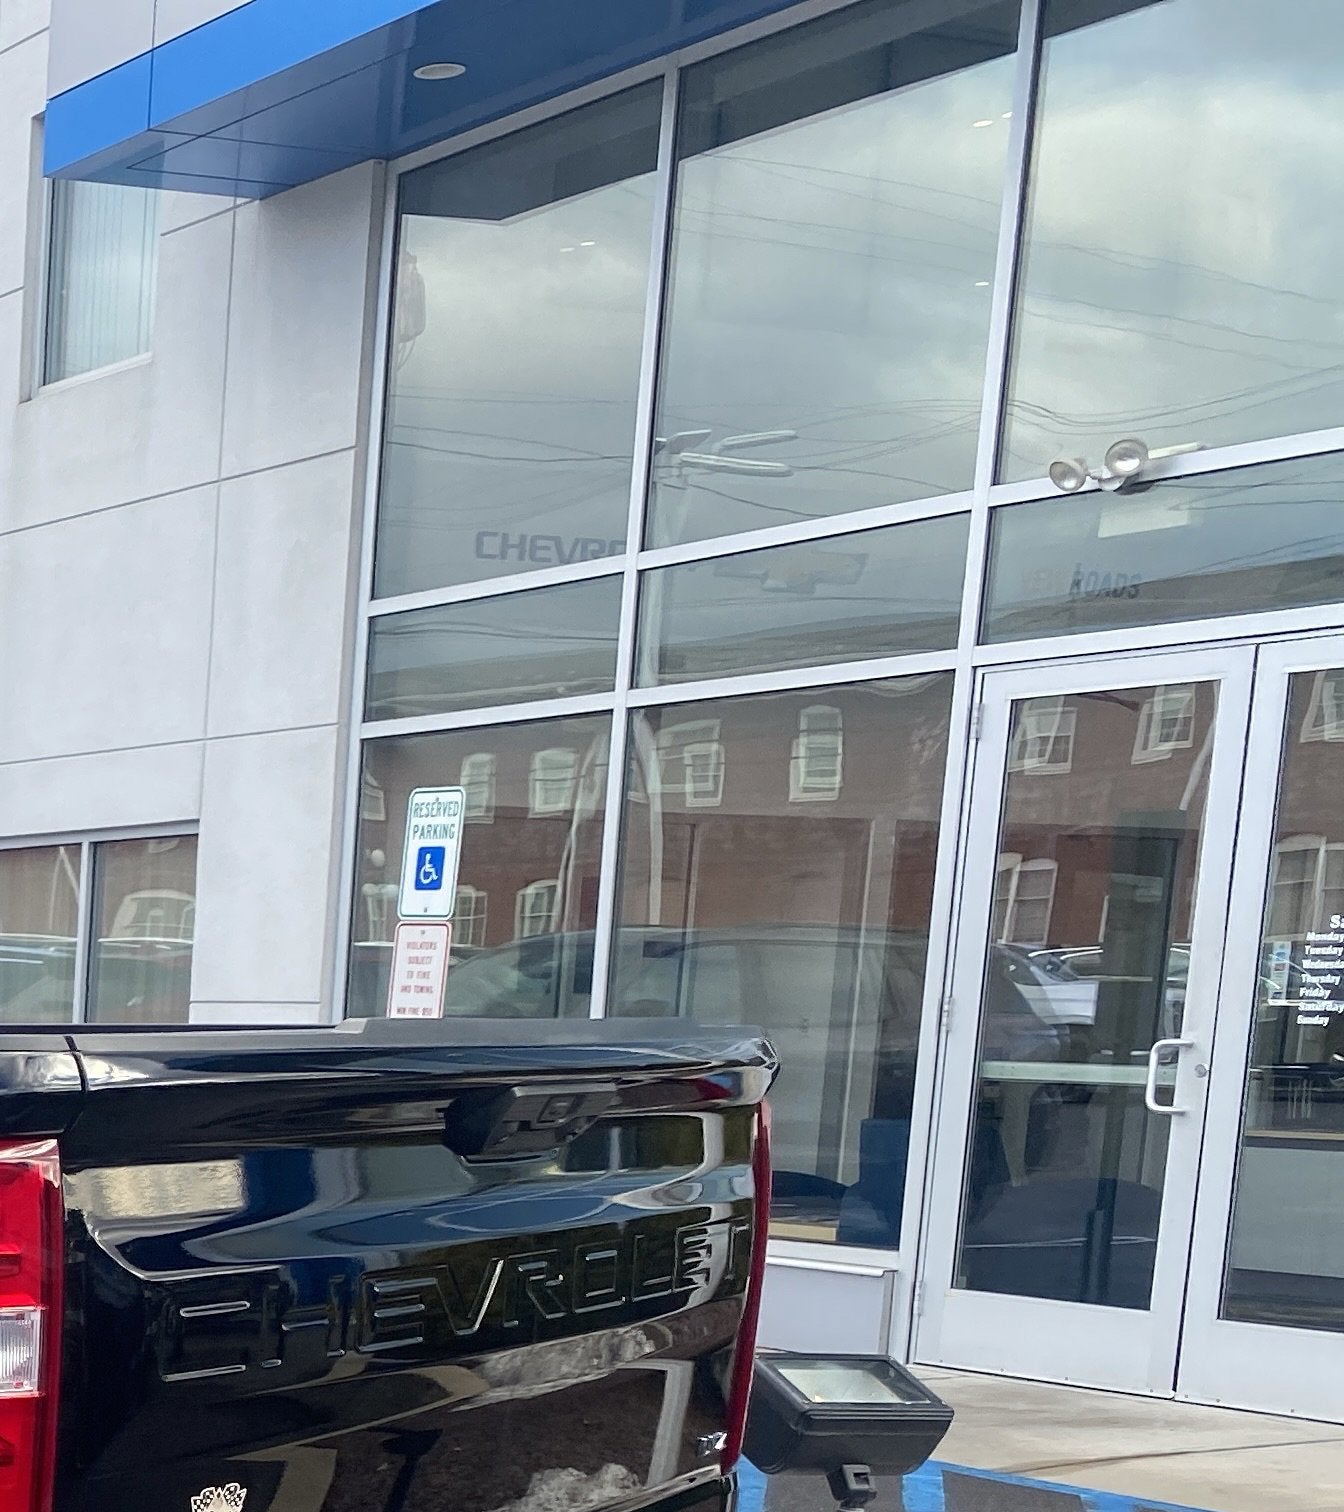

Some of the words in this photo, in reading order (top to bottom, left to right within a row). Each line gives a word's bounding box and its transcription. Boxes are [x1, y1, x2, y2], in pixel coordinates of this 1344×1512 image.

[413, 801, 459, 818] RESERVED
[413, 824, 455, 840] PARKING
[1305, 931, 1344, 943] Monday
[1304, 945, 1344, 956] Tuesday
[1301, 959, 1344, 969] Wednesda
[1301, 974, 1341, 986] Thursday
[1299, 987, 1332, 1000] Friday
[1297, 1002, 1344, 1014] Saturday
[1296, 1014, 1330, 1027] Sunday
[159, 1214, 752, 1382] CHEVROLET
